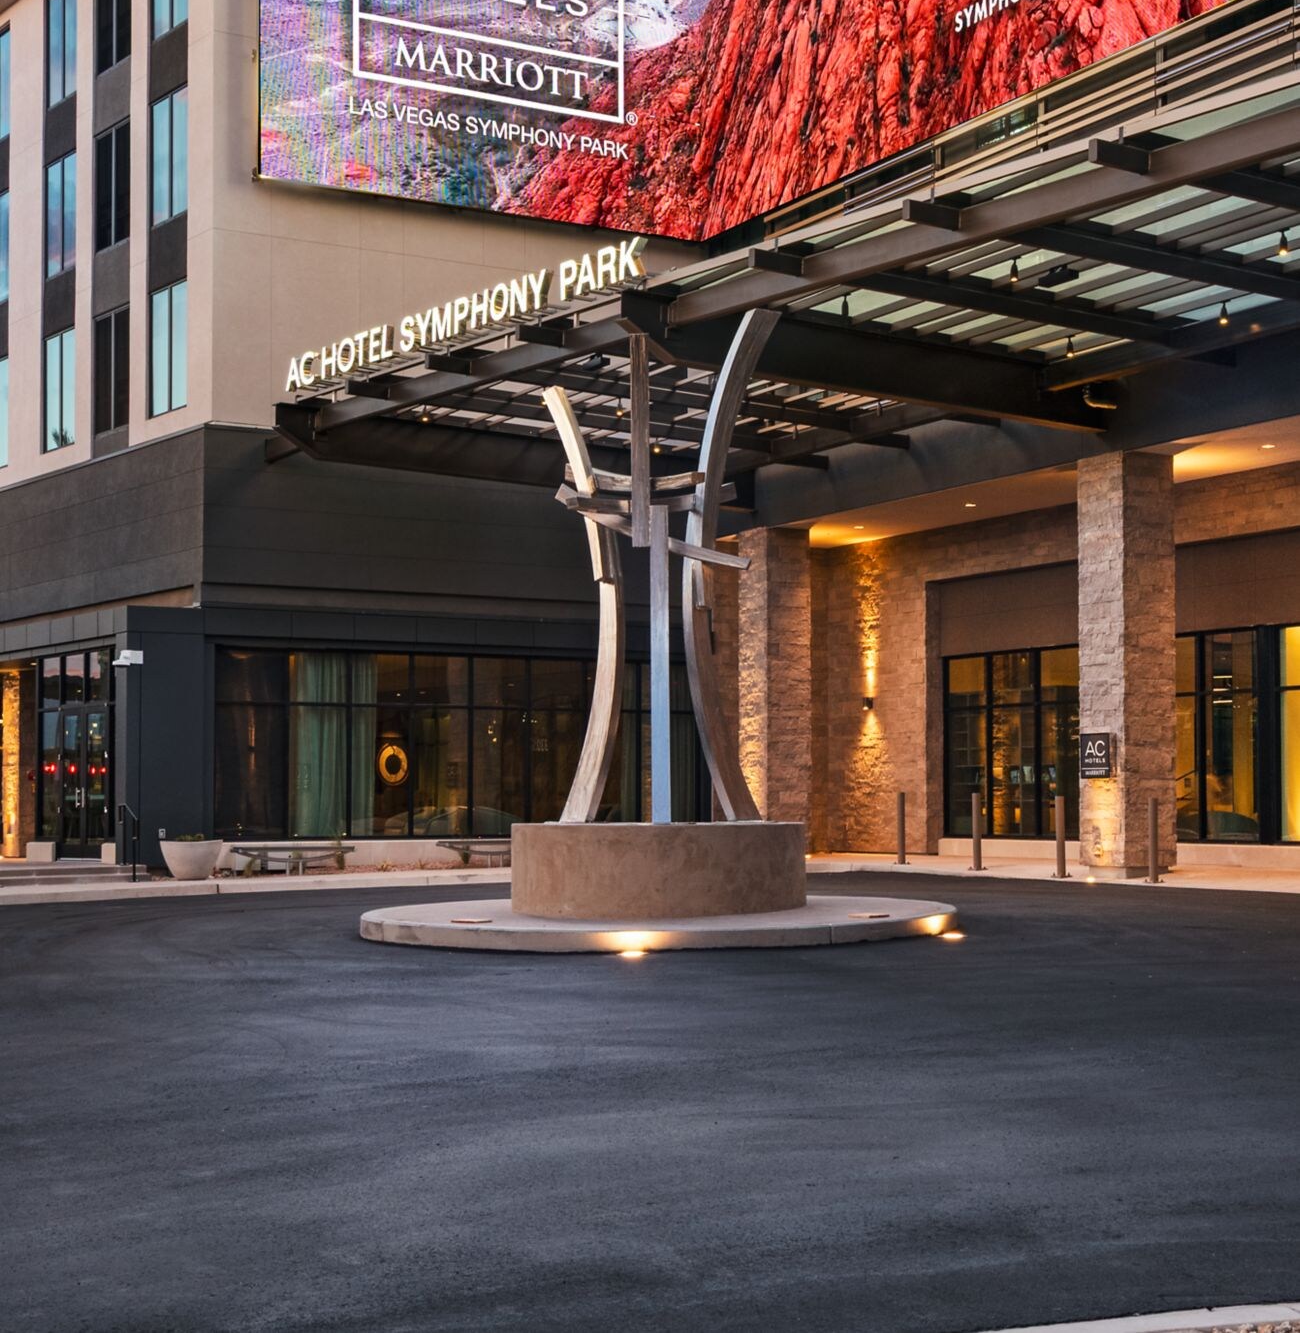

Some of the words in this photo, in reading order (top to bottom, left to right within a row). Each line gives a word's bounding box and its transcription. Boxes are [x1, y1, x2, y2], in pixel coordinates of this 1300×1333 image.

[395, 37, 589, 101] MARRIOTT
[348, 96, 388, 118] LAS
[393, 102, 461, 131] VEGAS
[465, 116, 578, 152] SYMPHONY
[580, 137, 629, 160] PARK
[285, 350, 315, 392] AC
[320, 324, 394, 379] HOTEL
[399, 268, 553, 353] SYMPHONY
[559, 236, 648, 302] PARK
[1085, 740, 1106, 757] AC
